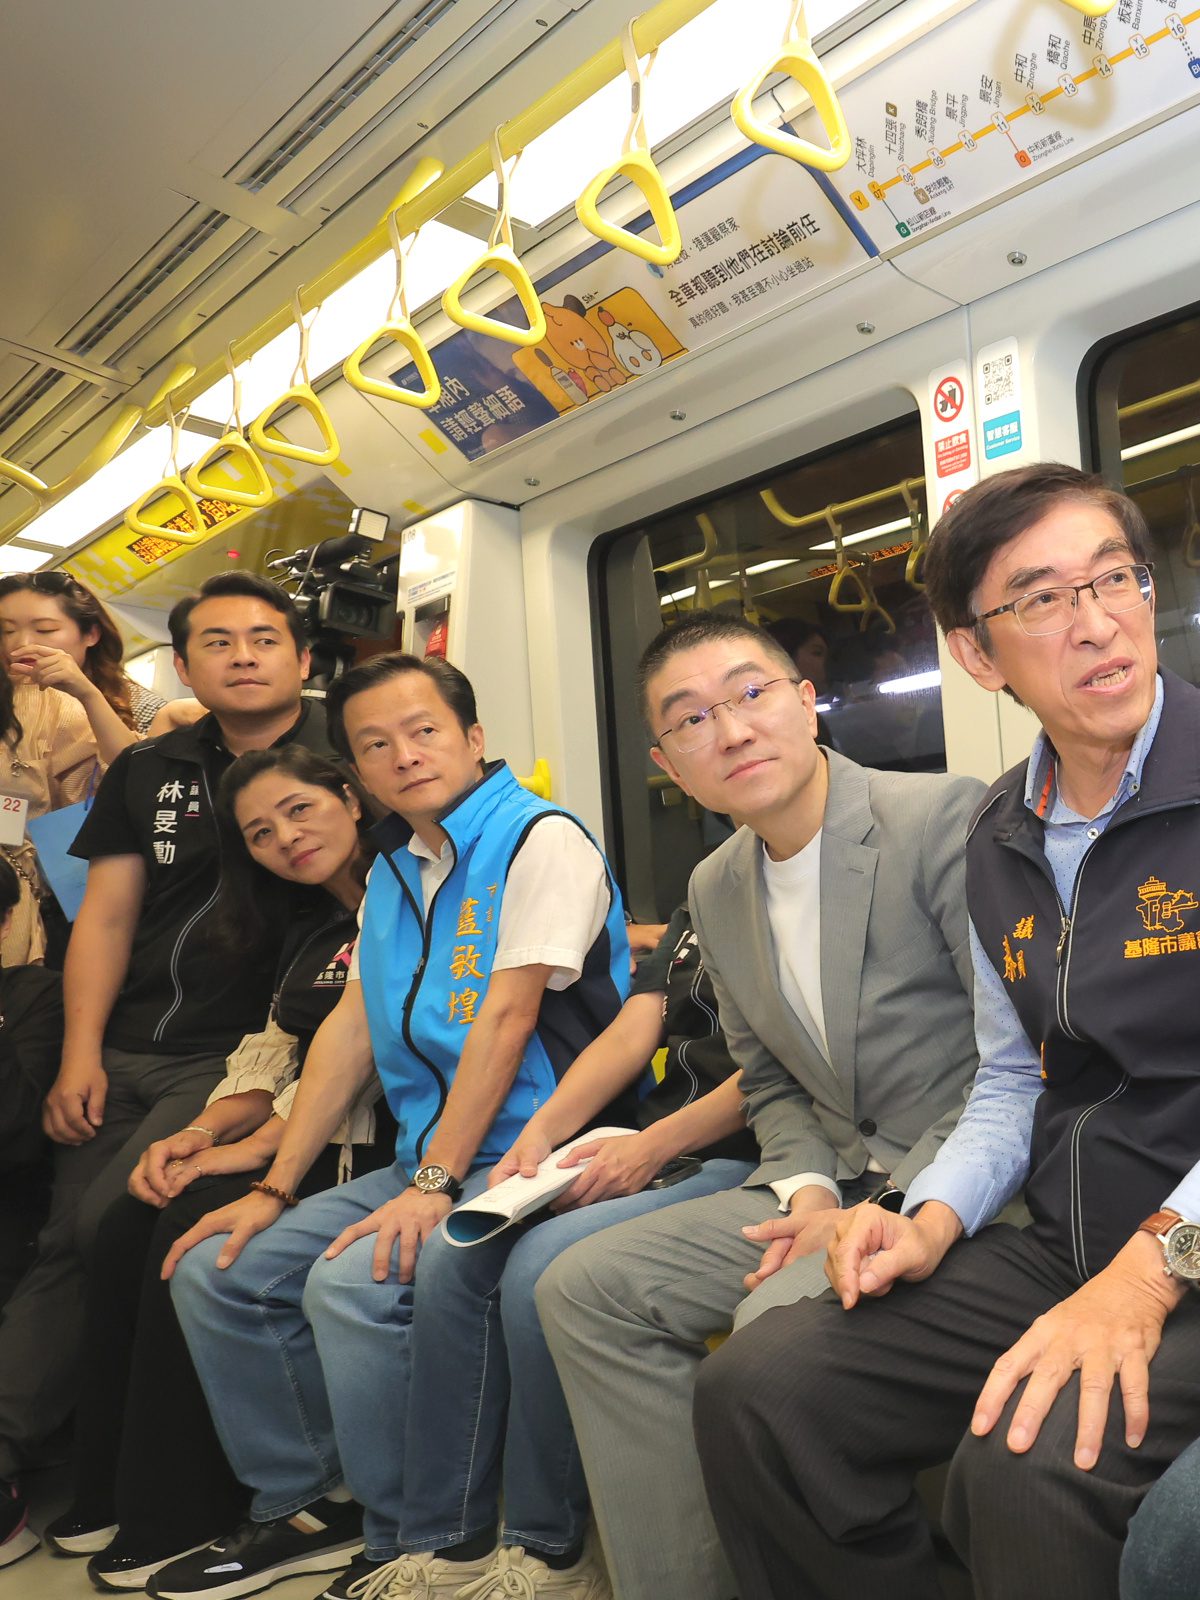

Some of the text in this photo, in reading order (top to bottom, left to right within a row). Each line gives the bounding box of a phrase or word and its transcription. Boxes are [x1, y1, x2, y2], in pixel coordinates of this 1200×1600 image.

[1171, 23, 1184, 36] 16
[1060, 40, 1071, 70] Qiaohe
[1135, 43, 1148, 56] 15
[1014, 53, 1028, 83] 中和
[1026, 52, 1038, 90] Zhonghe
[1099, 64, 1111, 76] 14
[1065, 83, 1077, 95] 13
[1031, 101, 1044, 113] 12
[997, 120, 1008, 132] 11
[964, 139, 975, 150] 10
[932, 156, 944, 167] 09
[902, 172, 914, 183] 08
[668, 213, 821, 308] 全車都聽到他們在討論前任
[3, 797, 21, 812] 22
